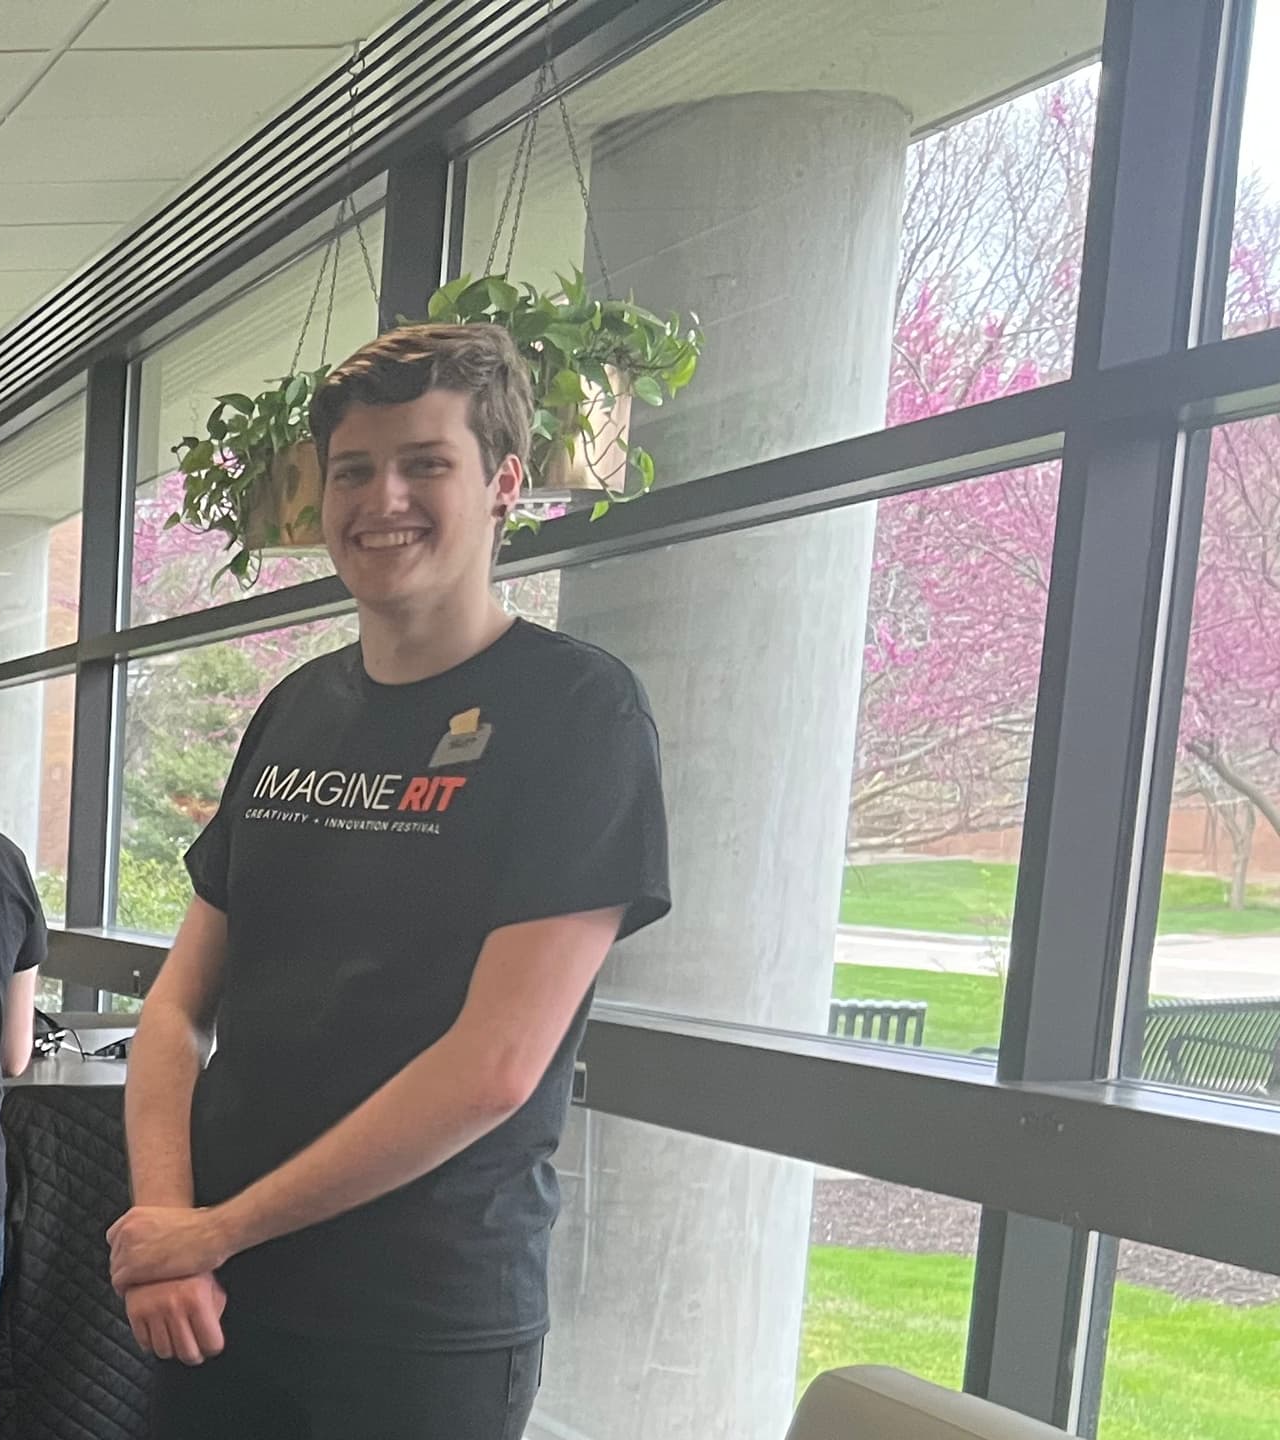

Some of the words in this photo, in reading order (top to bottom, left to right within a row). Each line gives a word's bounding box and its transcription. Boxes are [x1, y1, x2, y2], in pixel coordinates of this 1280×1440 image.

[253, 765, 402, 810] IMAGINE
[398, 776, 467, 811] RIT
[245, 808, 309, 824] CREATIVITY
[324, 817, 389, 832] INNOVATION
[391, 822, 440, 834] FESTIVAL
